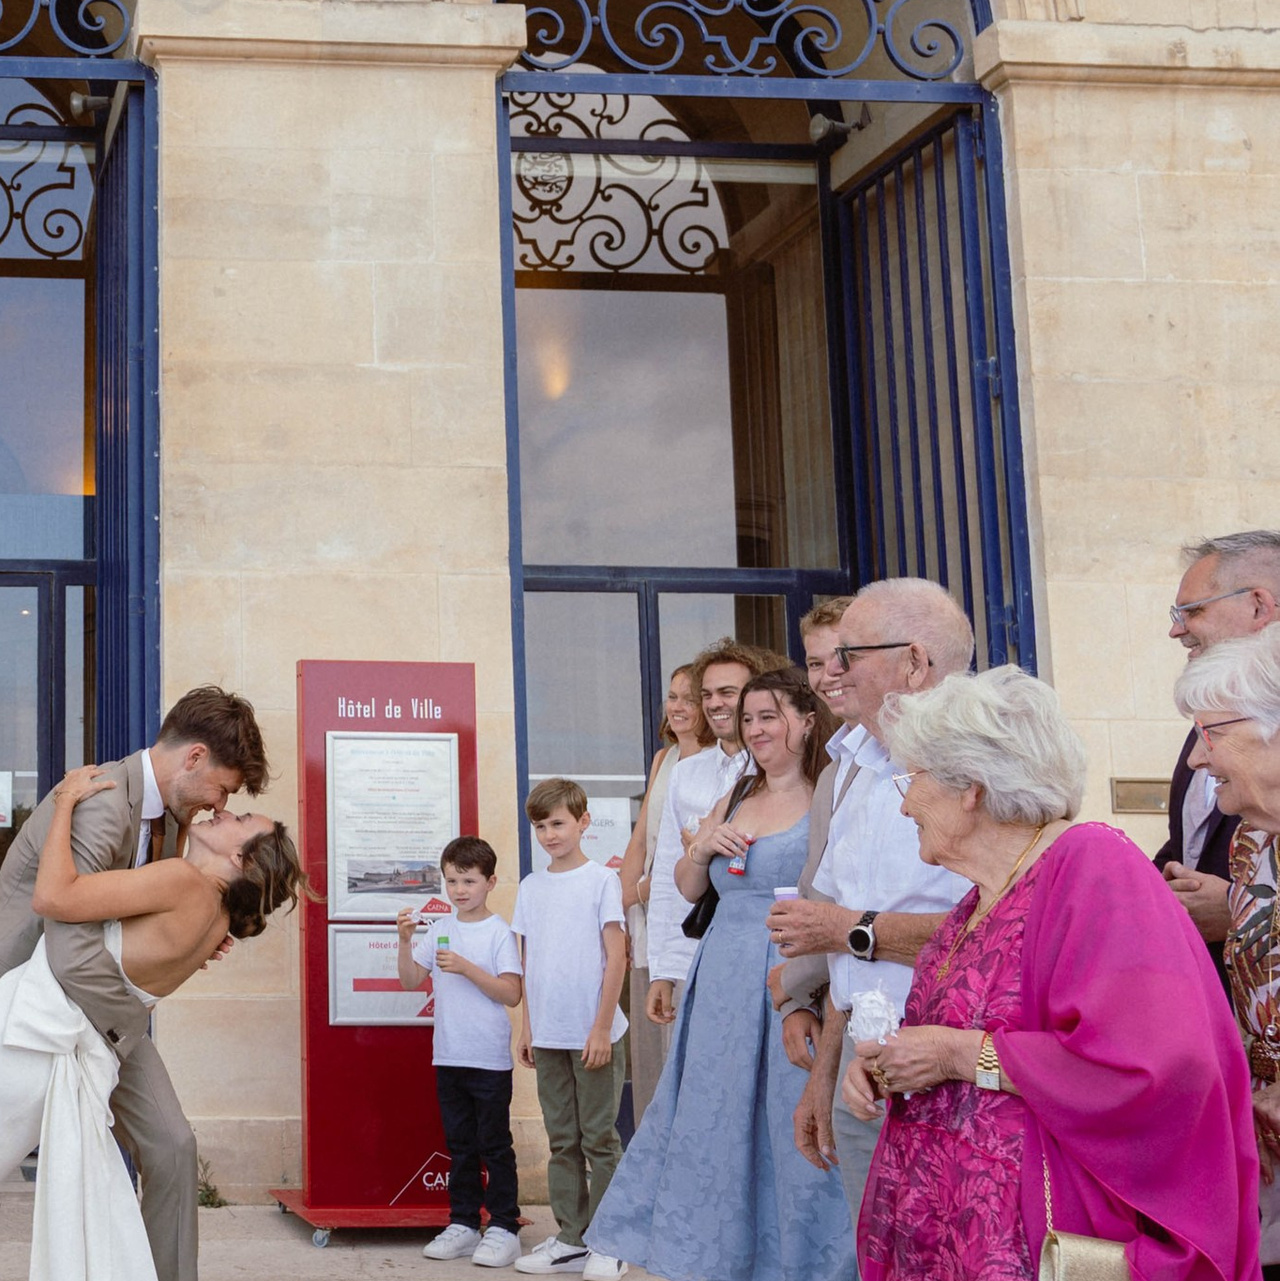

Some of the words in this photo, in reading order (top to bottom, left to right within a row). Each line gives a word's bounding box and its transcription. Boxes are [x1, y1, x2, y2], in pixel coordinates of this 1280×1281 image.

[337, 697, 376, 719] Hôtel
[384, 698, 402, 719] de
[411, 698, 442, 720] Ville
[368, 941, 391, 949] Hôtel
[392, 941, 398, 949] d
